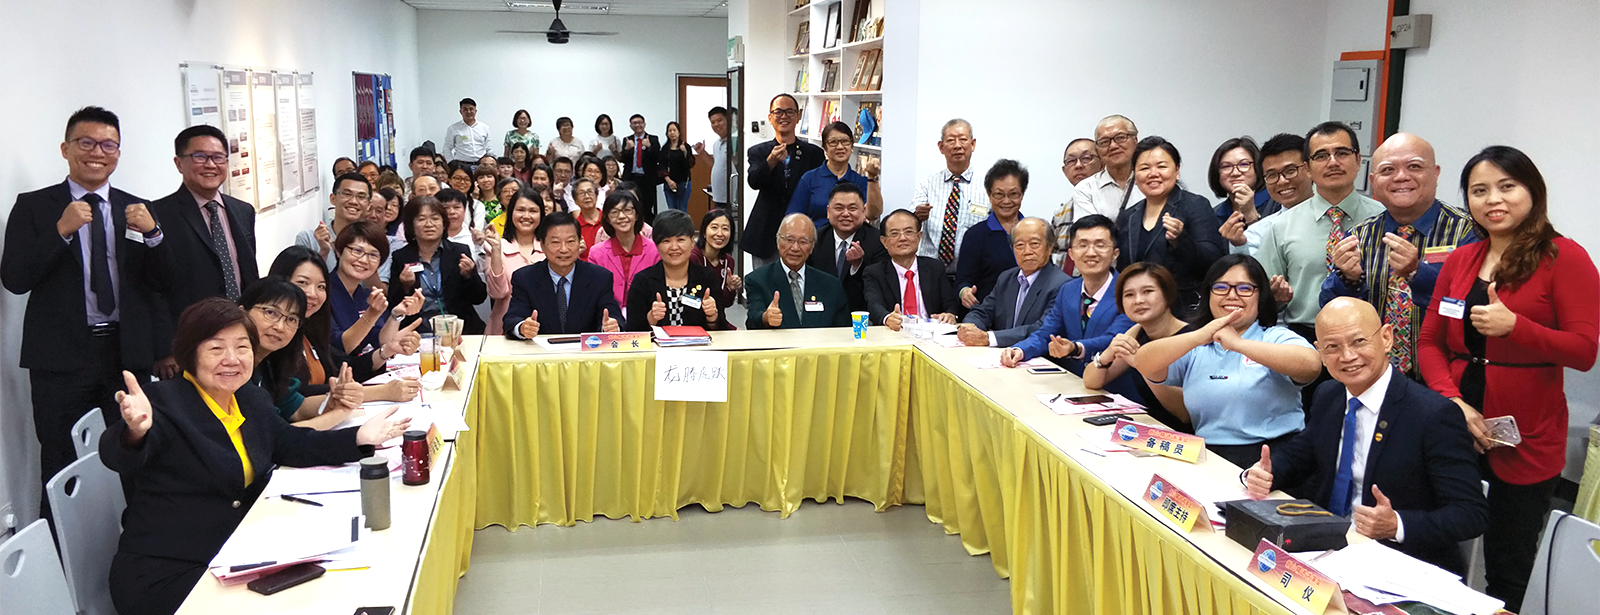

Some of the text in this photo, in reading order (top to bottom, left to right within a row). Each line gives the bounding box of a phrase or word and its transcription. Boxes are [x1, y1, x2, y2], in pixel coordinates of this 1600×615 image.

[611, 340, 639, 348] 会长
[1146, 437, 1184, 456] 备稿员
[1280, 571, 1315, 602] 司仪
